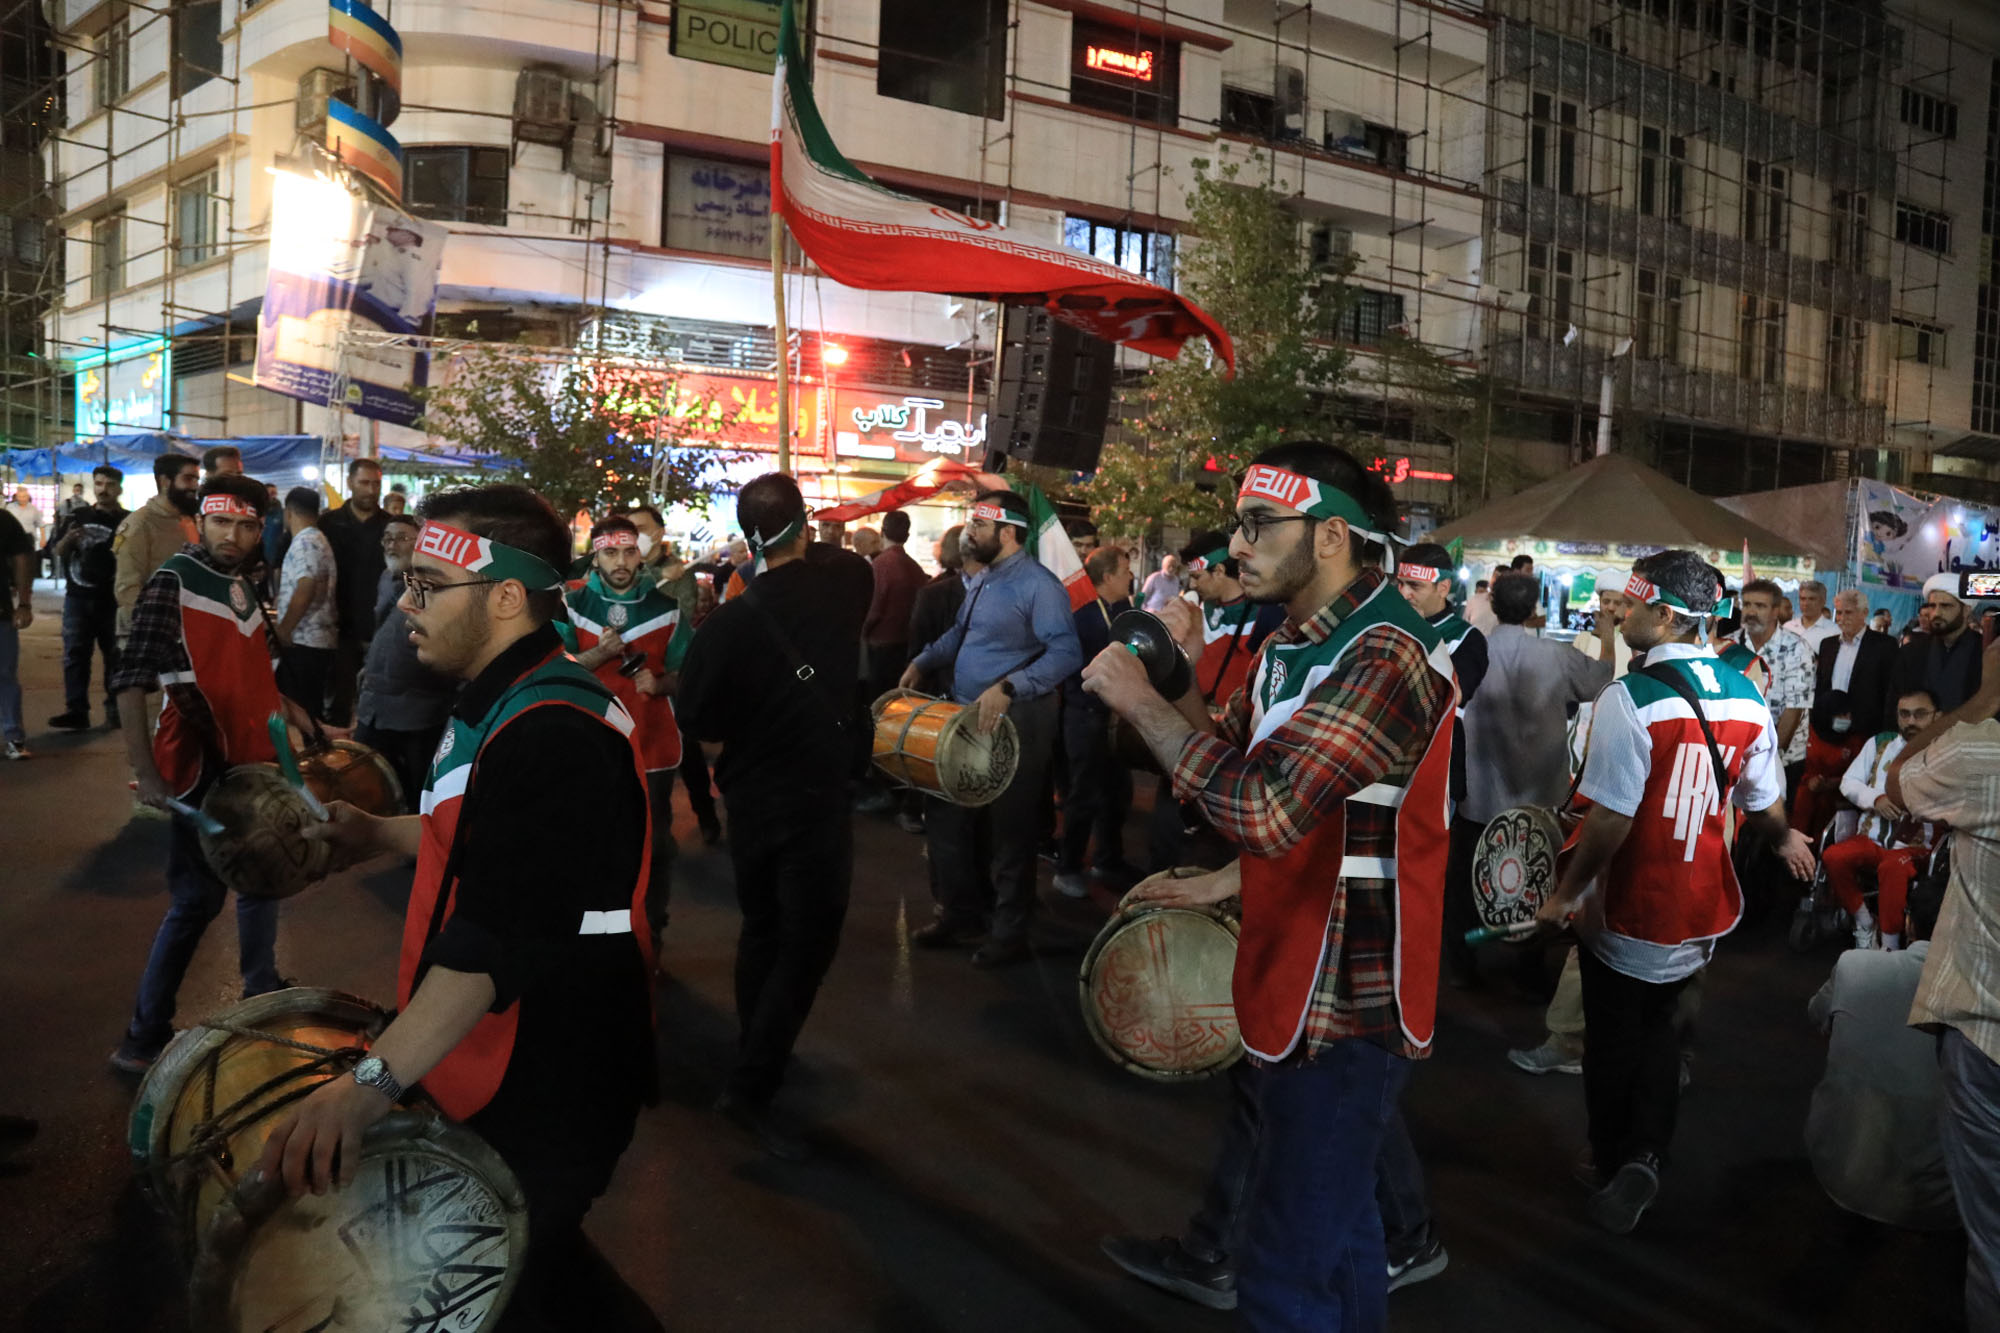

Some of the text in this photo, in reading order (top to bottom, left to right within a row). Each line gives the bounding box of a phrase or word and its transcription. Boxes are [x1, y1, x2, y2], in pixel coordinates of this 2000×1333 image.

[688, 15, 778, 55] POLIC
[1251, 468, 1302, 502] الله
[421, 526, 472, 564] الله
